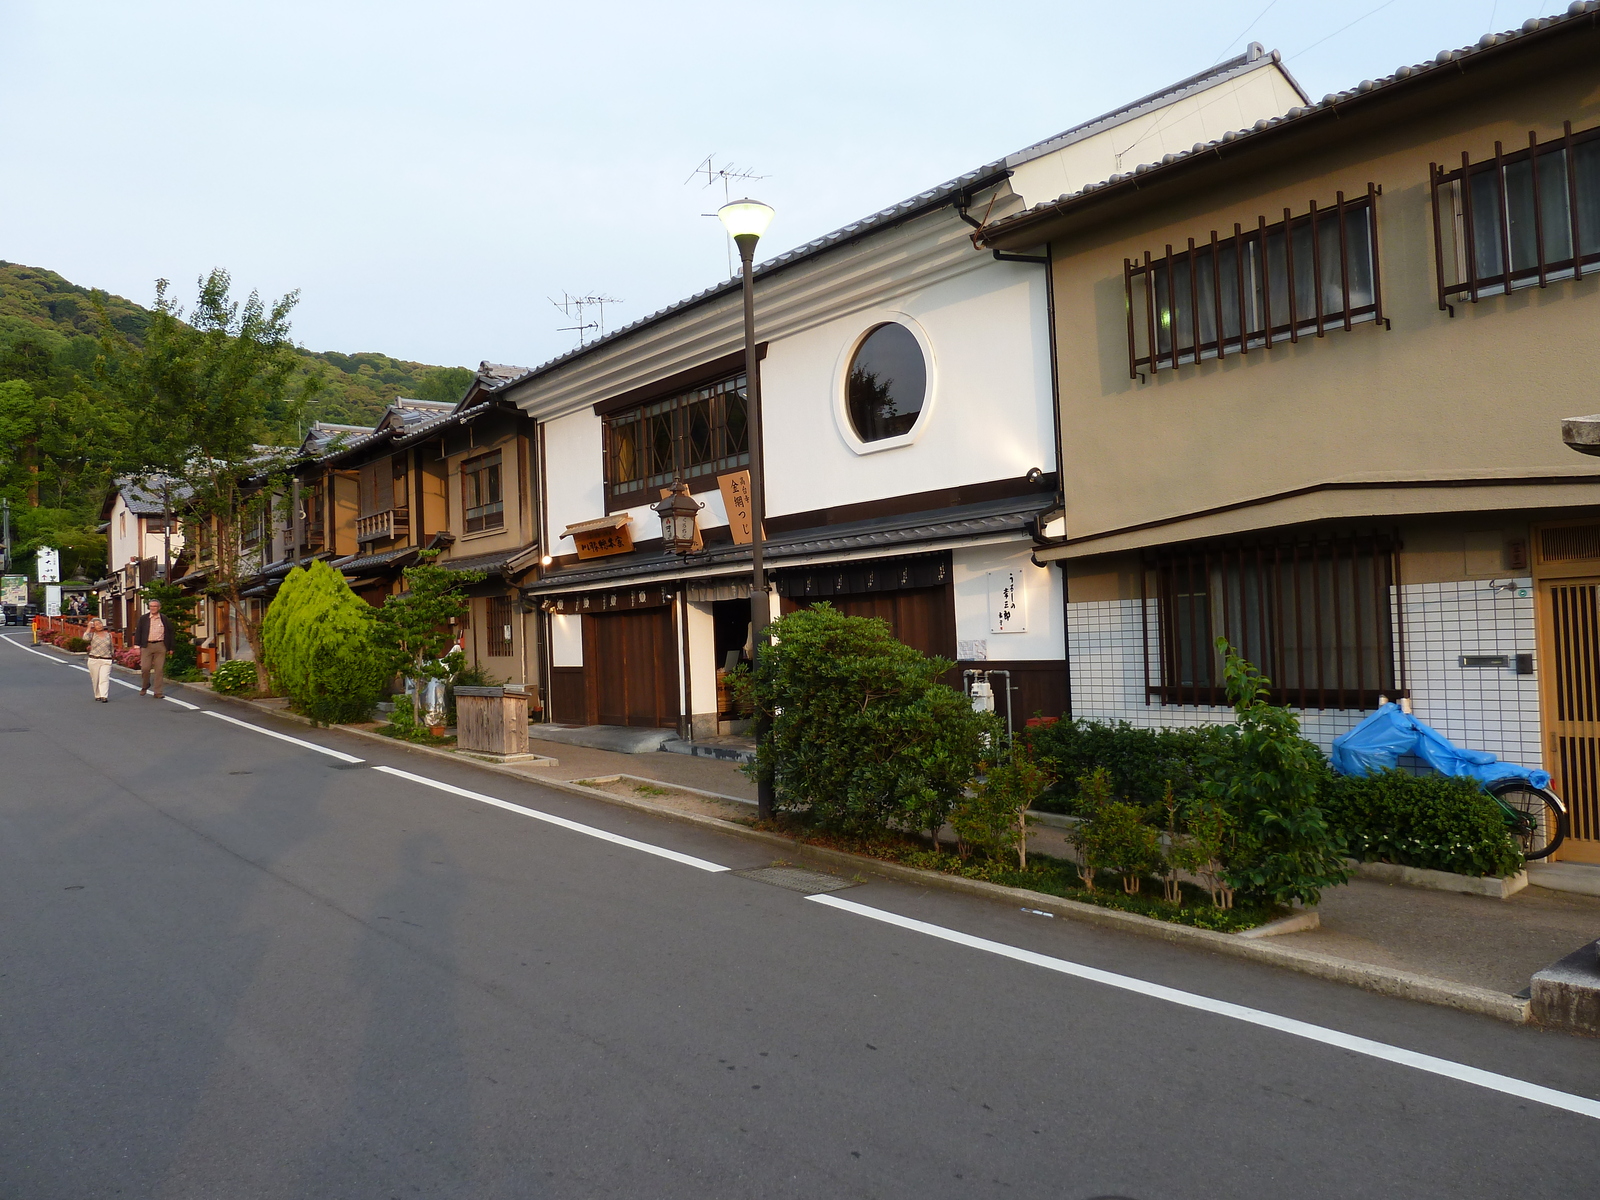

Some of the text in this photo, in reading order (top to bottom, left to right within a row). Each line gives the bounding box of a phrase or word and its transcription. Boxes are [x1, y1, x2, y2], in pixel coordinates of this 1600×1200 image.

[730, 479, 750, 535] 金網つじ
[1003, 587, 1011, 621] 幸三郎
